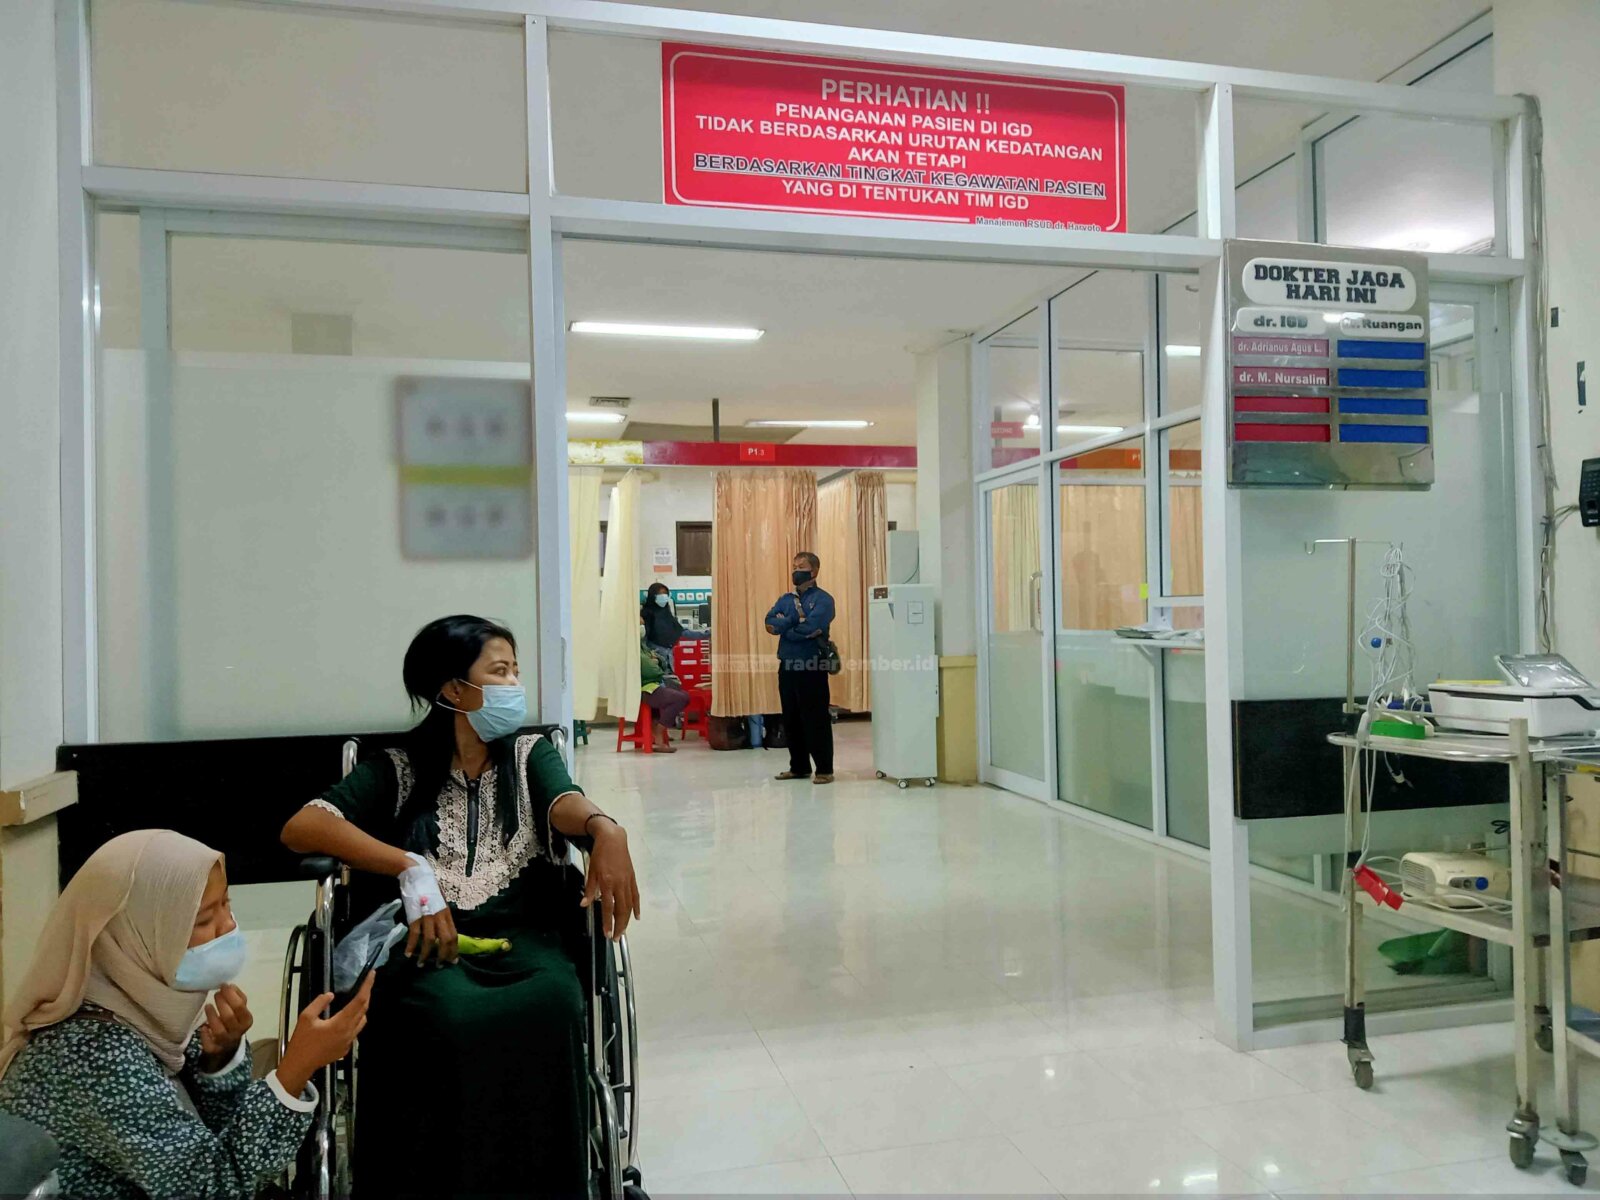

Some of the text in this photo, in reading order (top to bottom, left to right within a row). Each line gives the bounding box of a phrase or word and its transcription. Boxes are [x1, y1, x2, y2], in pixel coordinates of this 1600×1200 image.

[821, 78, 990, 115] PERHATIAN !!
[776, 102, 1033, 138] PENANGANAN PASIEN DI IGD
[696, 115, 1103, 161] TIDAK BERDASARKAN URUTAN KEDATANGAN
[848, 147, 966, 169] AKAN TETAPI
[694, 154, 1105, 197] BERDASARKAN TINGKAT KEGAWATAN PASIEN
[781, 180, 1029, 210] YANG DI TENTUKAN TIM IGD
[976, 217, 1025, 228] Manajemen
[1026, 219, 1053, 229] RSUD
[1254, 264, 1405, 289] DOKTER JAGA
[1286, 283, 1377, 304] HARI INI
[1253, 315, 1308, 329] dr. IGD
[1362, 318, 1422, 332] Ruangan
[1238, 342, 1249, 351] dr.
[1251, 341, 1288, 352] Adrianus
[1291, 343, 1312, 355] Agus
[1239, 371, 1327, 385] dr. M. Nursalim
